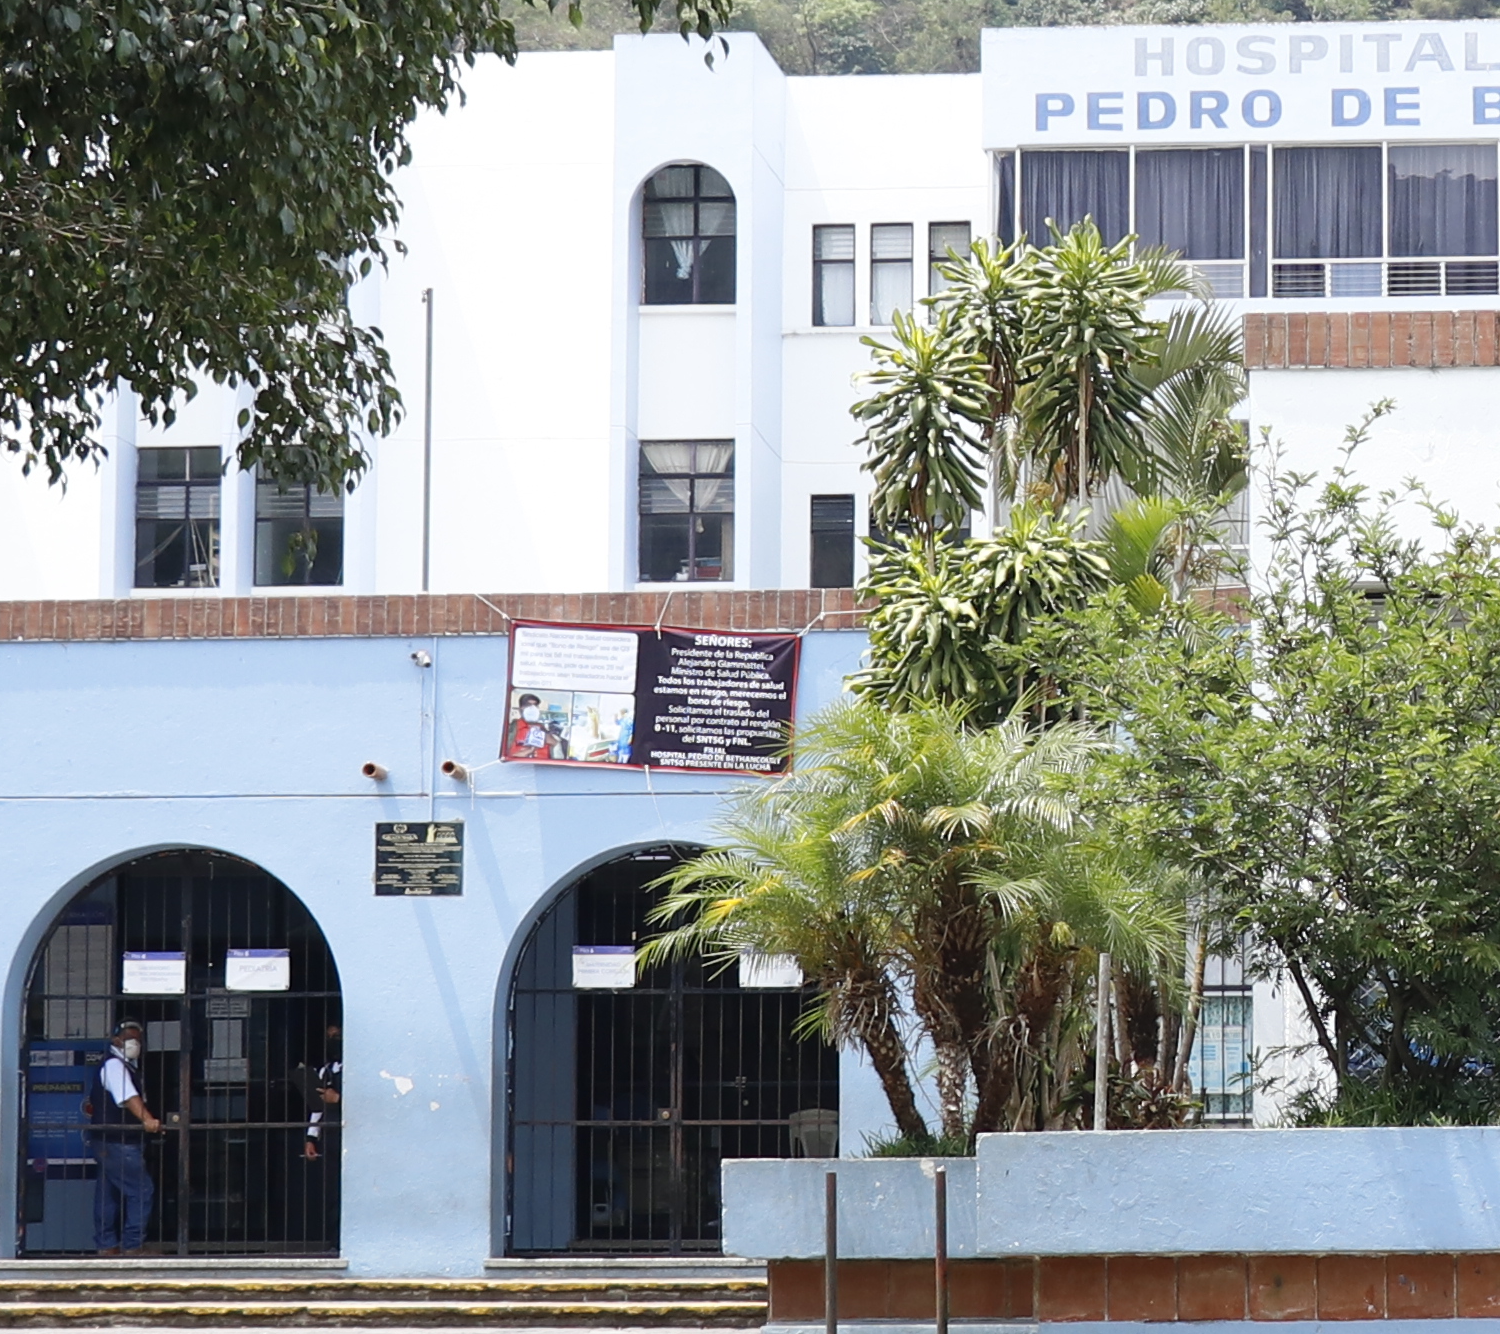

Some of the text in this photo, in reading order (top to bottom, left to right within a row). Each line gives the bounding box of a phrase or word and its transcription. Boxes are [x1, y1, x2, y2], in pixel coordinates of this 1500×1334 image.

[1134, 31, 1500, 77] HOSPITAL
[1035, 89, 1282, 132] PEDRO
[1331, 87, 1420, 127] DE
[695, 635, 752, 648] SEÑORES:
[671, 648, 712, 658] Presidente
[735, 651, 774, 661] República
[678, 658, 716, 668] Alejandro
[671, 667, 704, 676] Ministro
[705, 669, 715, 677] de
[717, 669, 739, 677] Salud
[658, 676, 681, 684] Todos
[683, 677, 695, 685] los
[697, 678, 748, 689] trabajadores
[654, 687, 687, 695] estamos
[730, 691, 776, 699] merecemos
[778, 692, 786, 700] el
[688, 697, 709, 705] bono
[668, 705, 769, 718] Solicitamos el traslado del
[656, 715, 690, 725] personal
[706, 717, 739, 725] contrato
[741, 717, 748, 725] al
[679, 725, 722, 735] solicitamos
[724, 727, 734, 735] las
[682, 735, 695, 743] del
[697, 735, 724, 744] SNTSG
